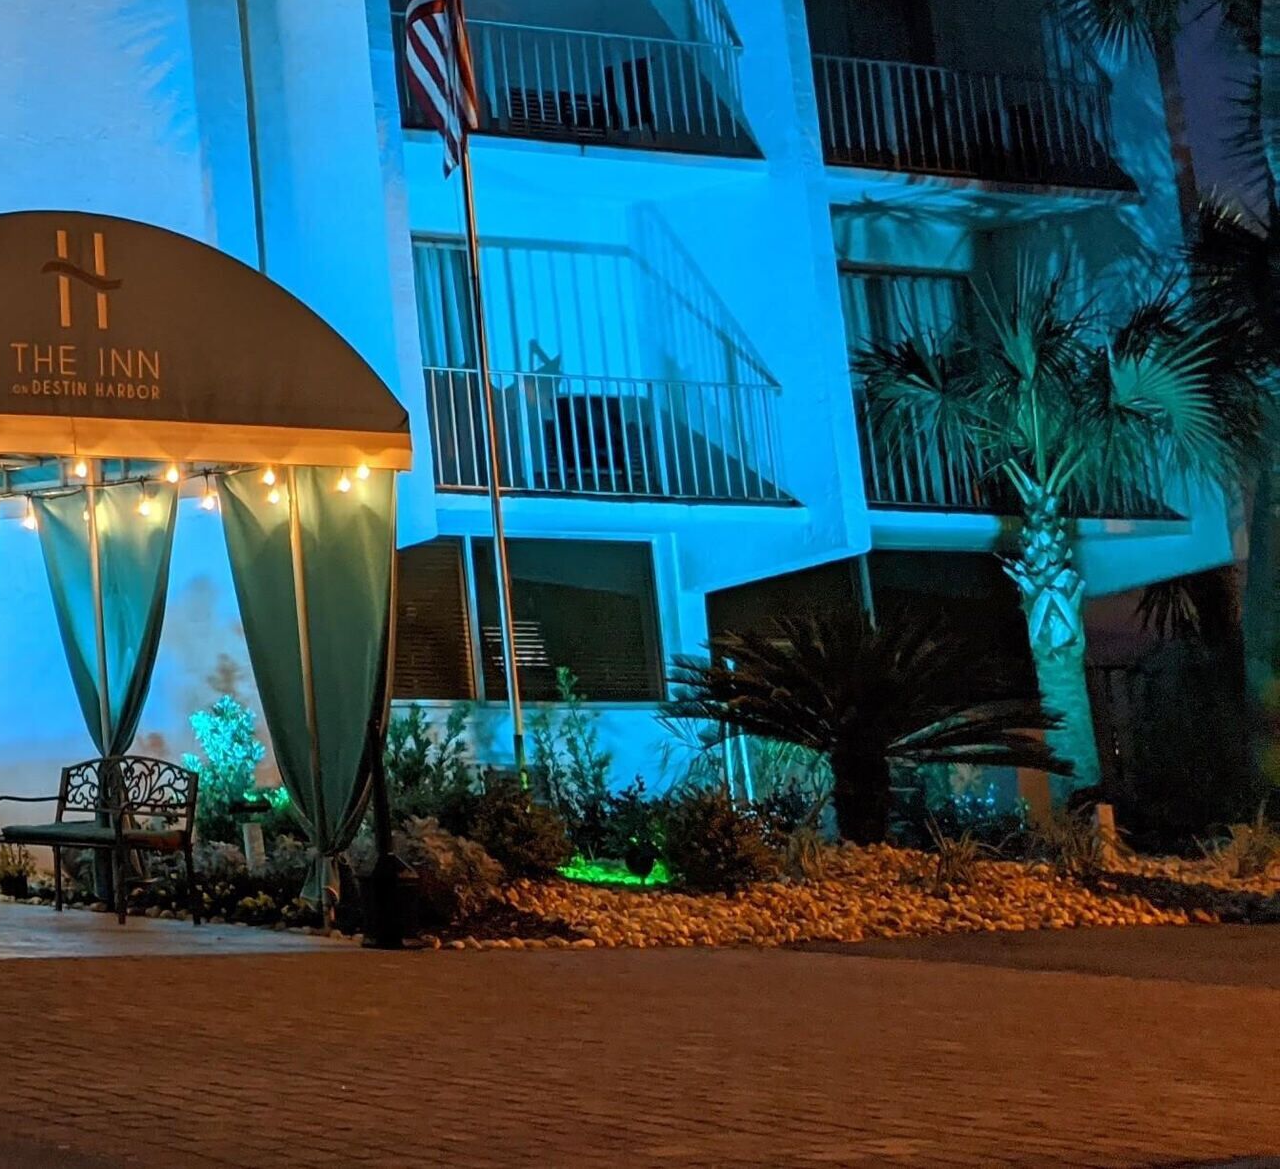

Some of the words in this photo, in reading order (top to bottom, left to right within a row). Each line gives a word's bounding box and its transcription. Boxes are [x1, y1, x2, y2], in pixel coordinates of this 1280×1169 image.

[10, 342, 77, 375] THE
[99, 347, 160, 380] INN
[32, 379, 87, 396] DESTIN
[95, 382, 160, 400] HARBOR
